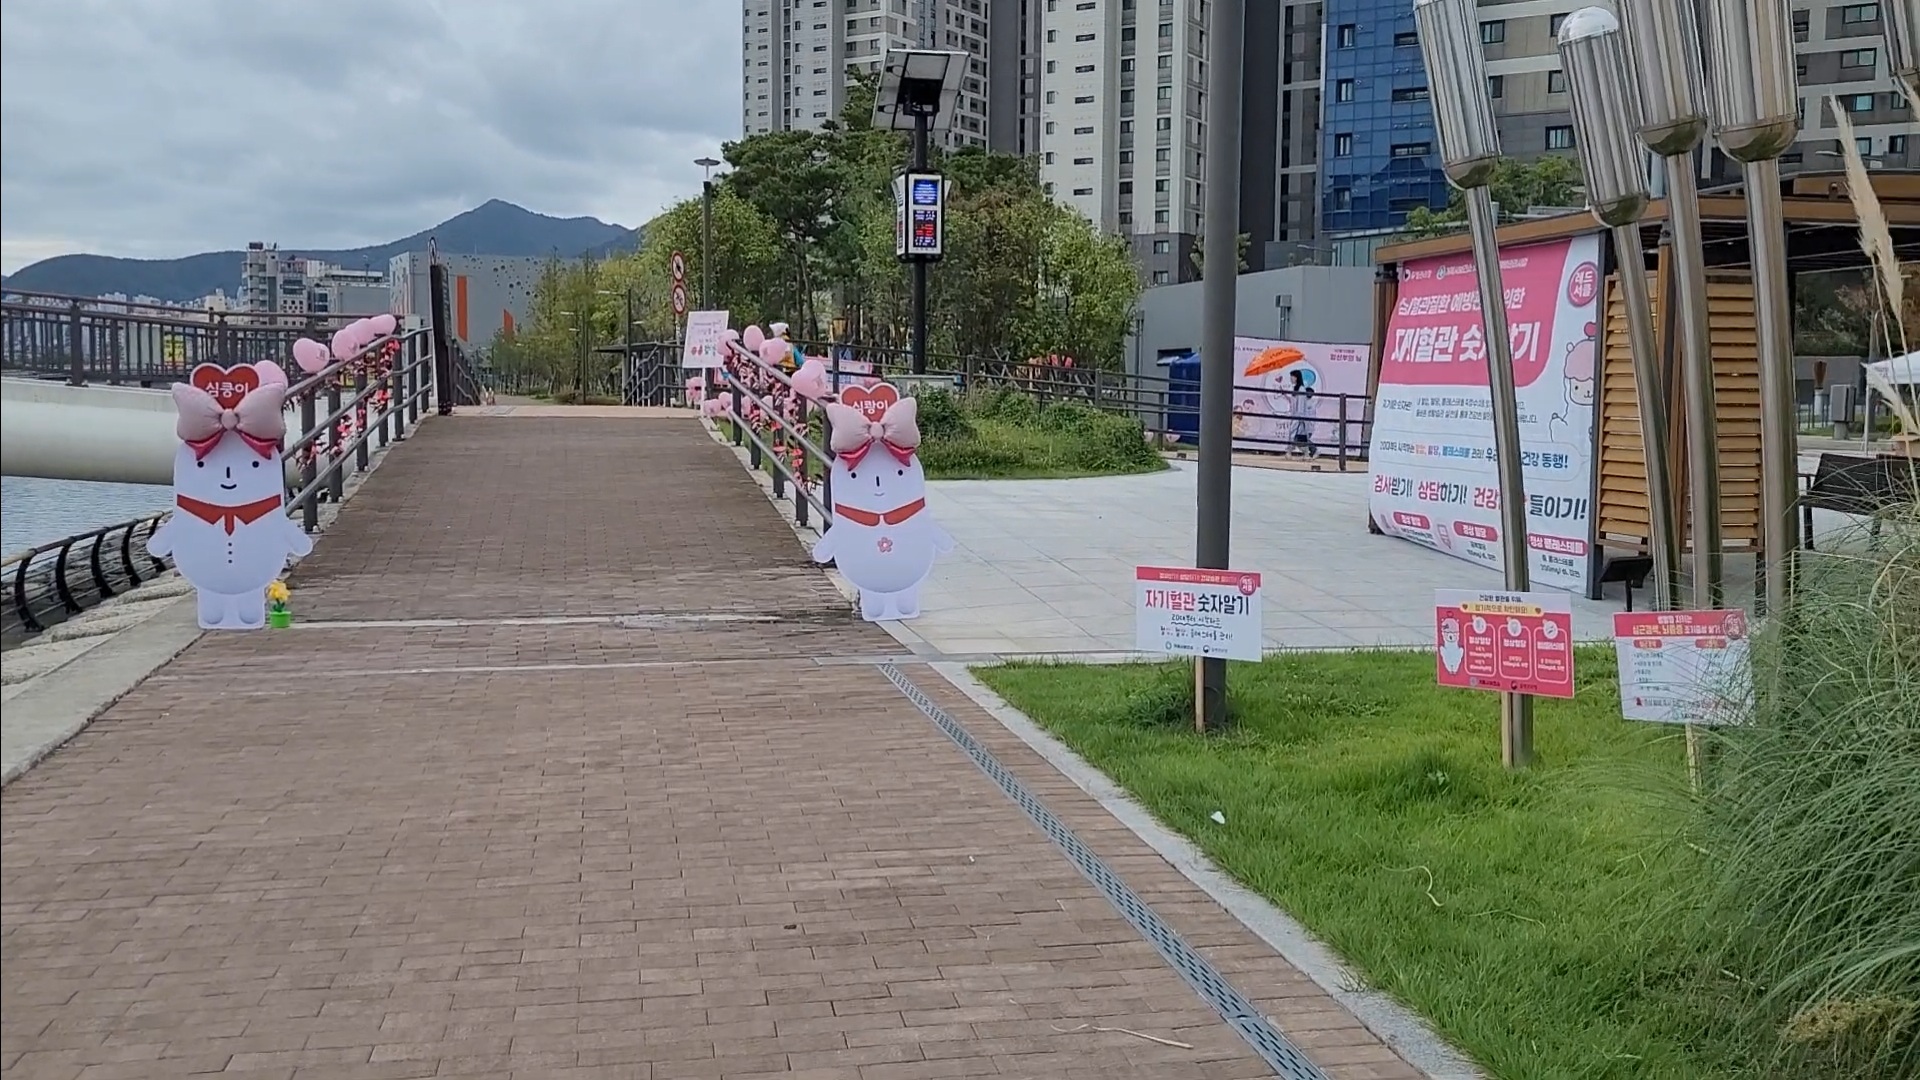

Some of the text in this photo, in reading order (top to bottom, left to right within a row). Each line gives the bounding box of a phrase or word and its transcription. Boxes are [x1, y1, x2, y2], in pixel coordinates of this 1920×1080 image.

[206, 382, 249, 398] 심쿵이
[1542, 452, 1568, 469] 동행!
[1374, 474, 1413, 498] 검사받기!
[1418, 480, 1467, 505] 상담하기!
[1530, 493, 1587, 520] 들이기!
[1146, 589, 1249, 616] 자기혈관 숫자알기
[1171, 614, 1196, 623] 20대부터
